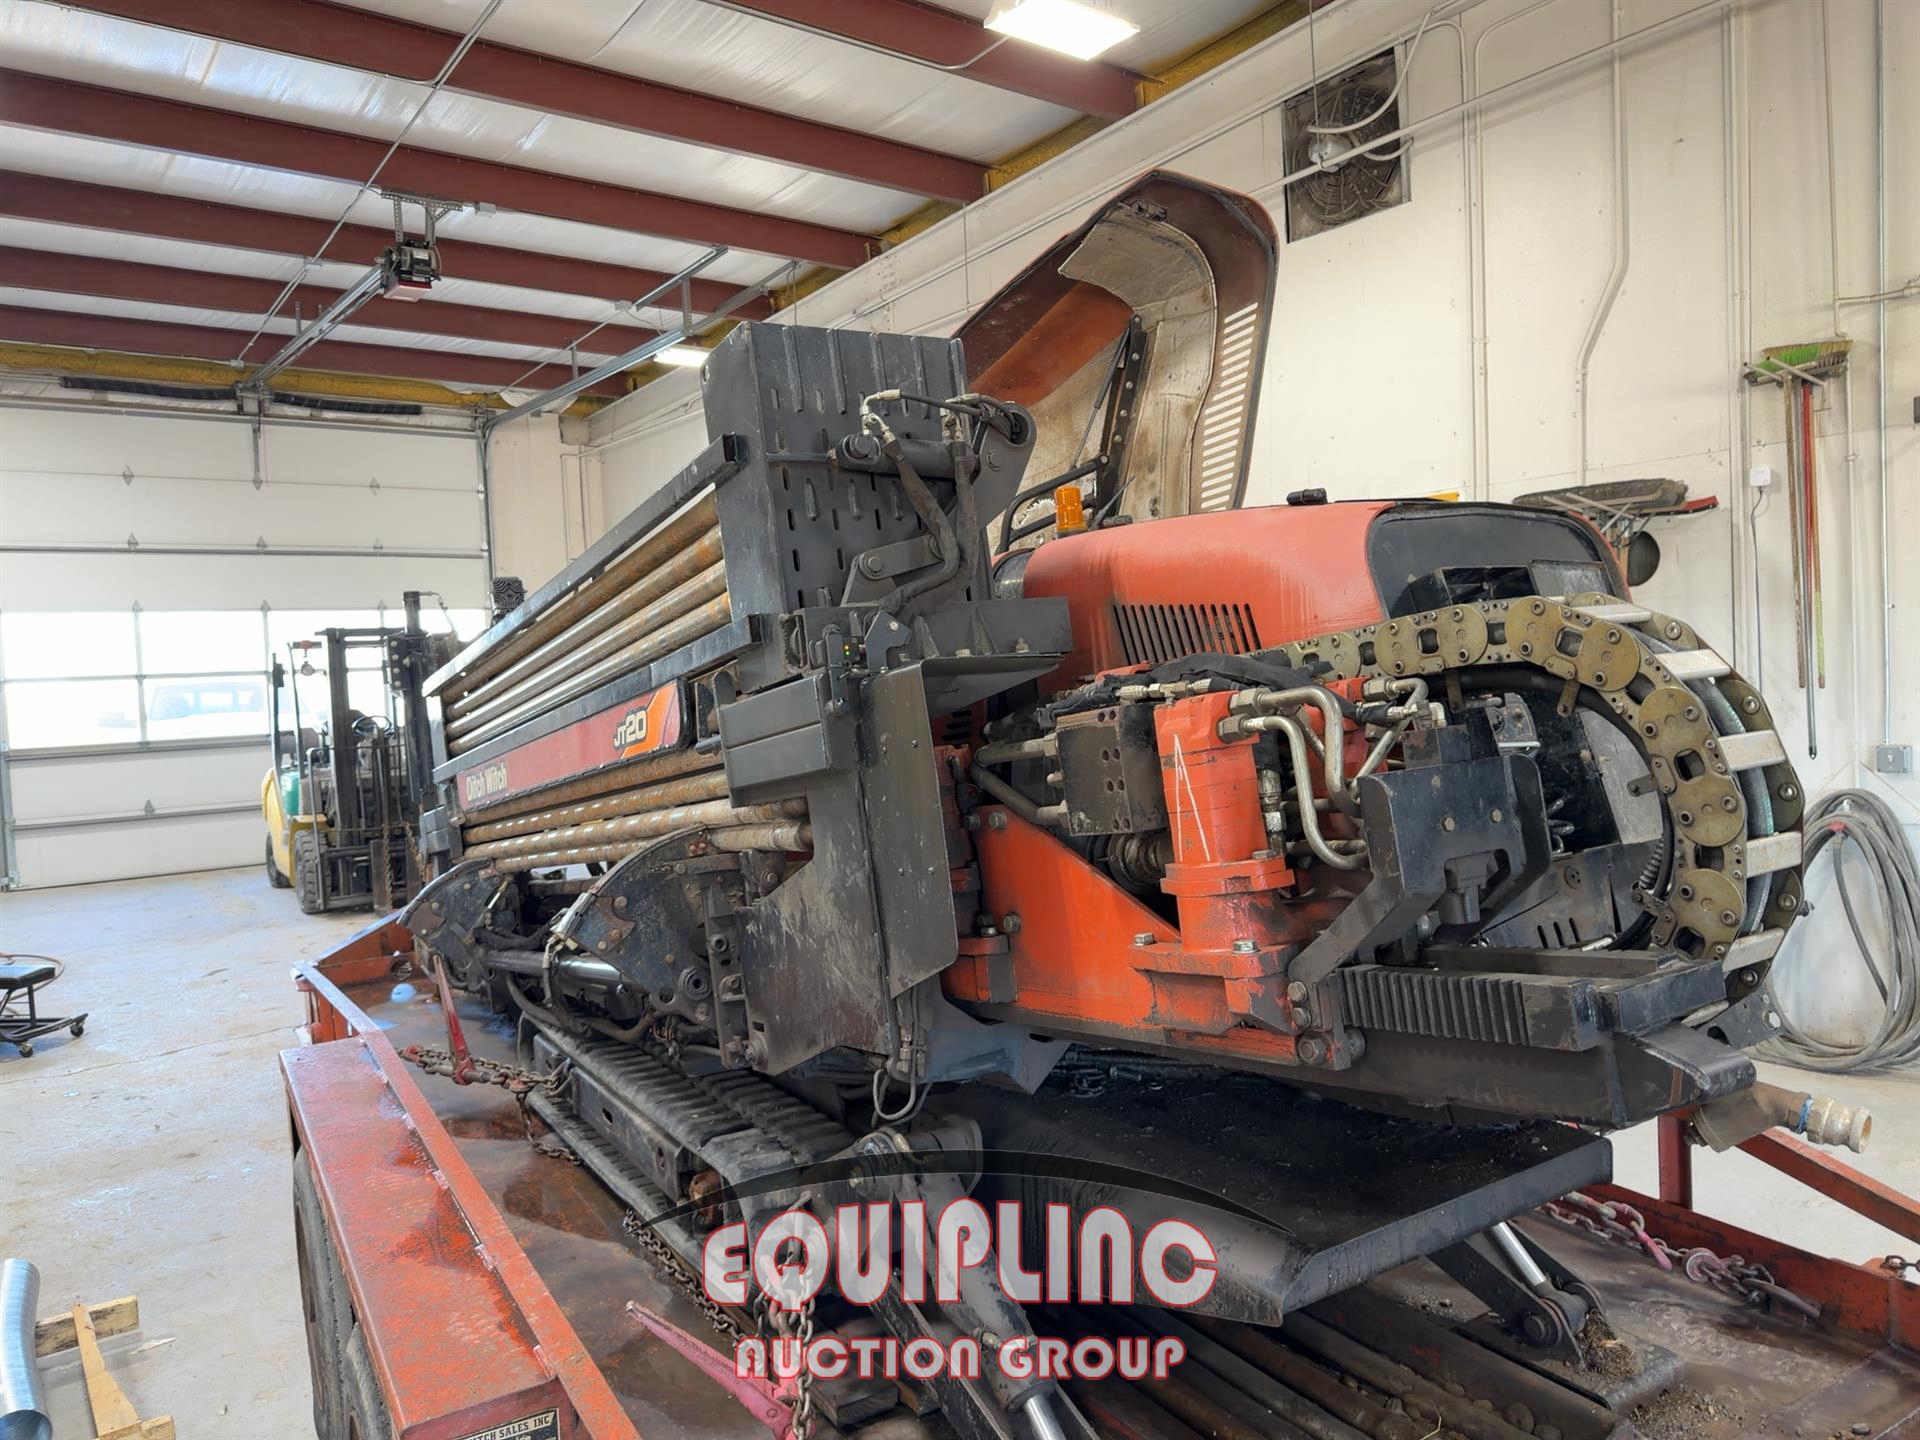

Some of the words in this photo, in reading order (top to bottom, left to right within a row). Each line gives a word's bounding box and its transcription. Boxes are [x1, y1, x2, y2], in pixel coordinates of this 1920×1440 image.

[613, 709, 647, 748] JT20
[466, 771, 485, 801] Ditch
[485, 762, 508, 795] Witch
[533, 1415, 550, 1428] INC
